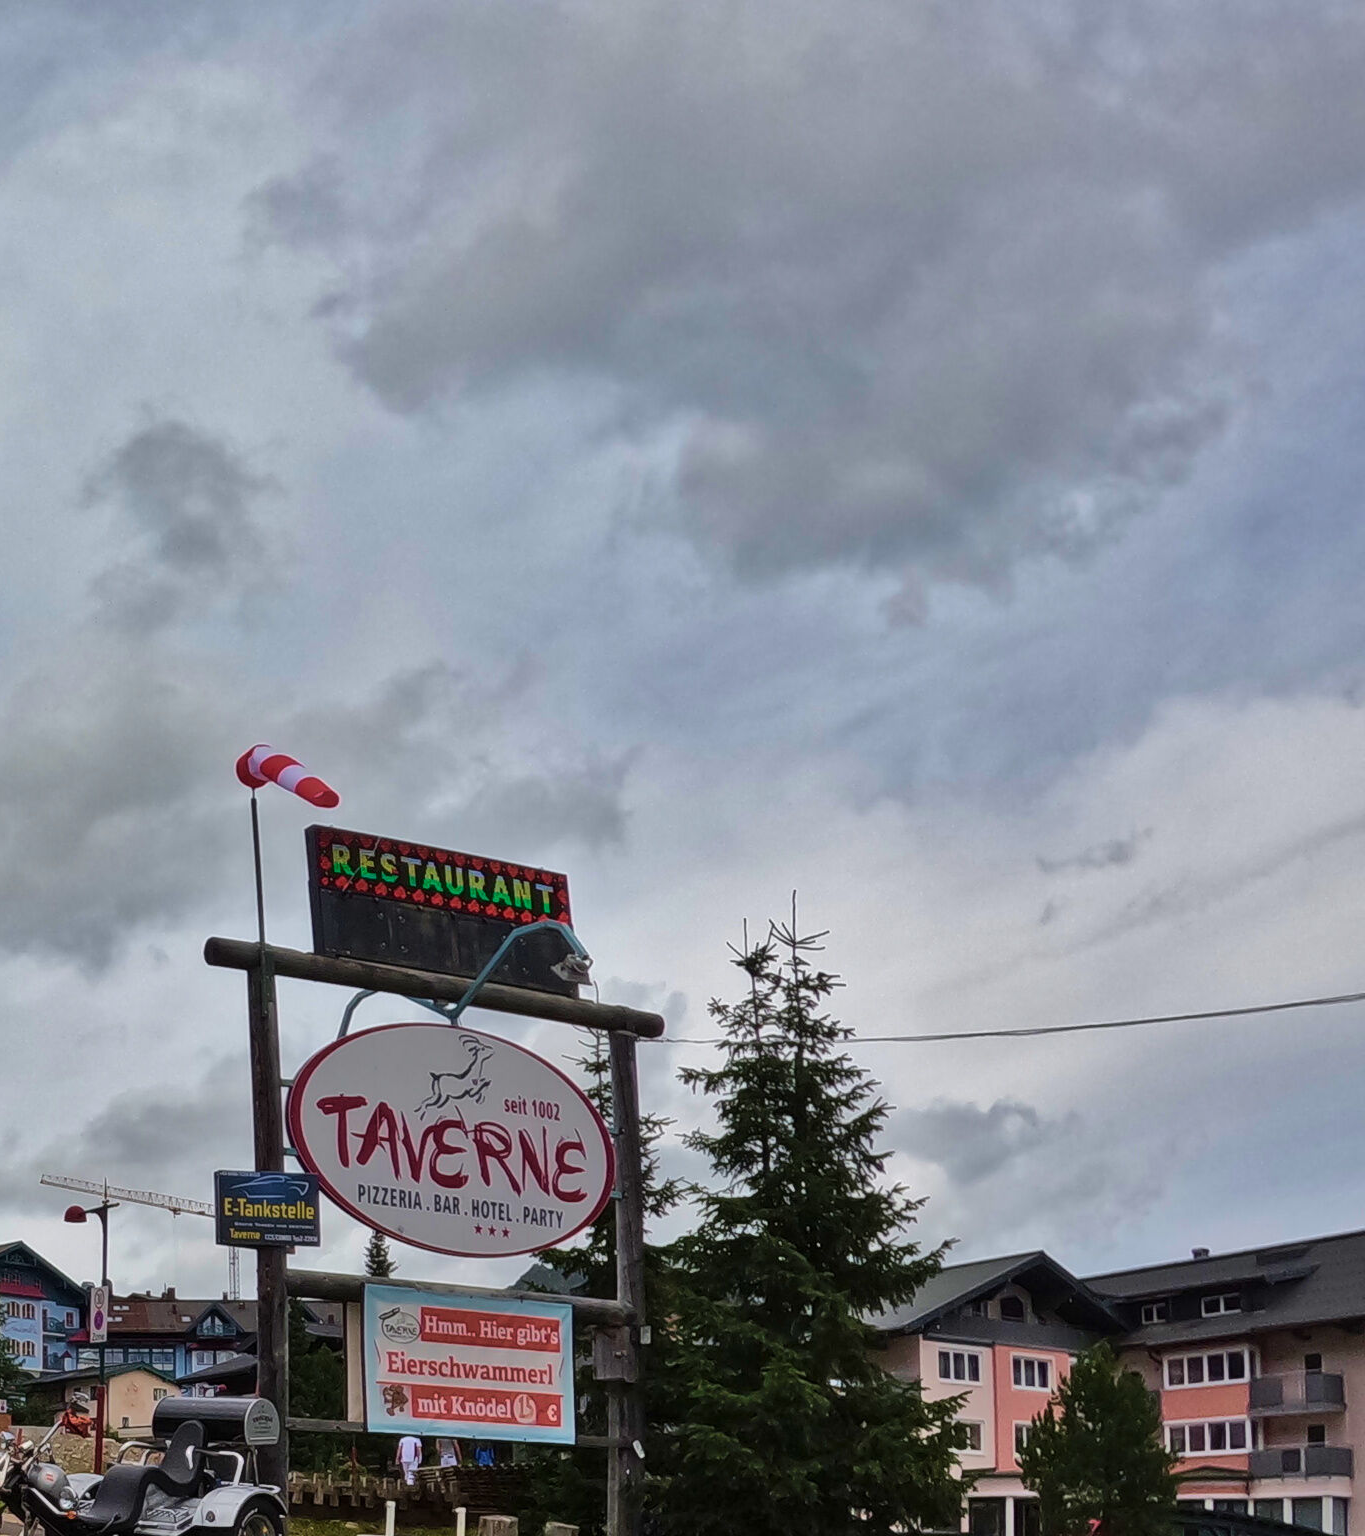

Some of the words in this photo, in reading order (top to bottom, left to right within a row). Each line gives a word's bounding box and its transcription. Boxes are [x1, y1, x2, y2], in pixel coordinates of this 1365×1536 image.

[332, 844, 554, 914] RESTAURANT
[504, 1095, 527, 1115] seit
[532, 1100, 560, 1121] 1002
[316, 1094, 587, 1203] TAVERNE
[224, 1197, 315, 1220] E-Tankstelle
[357, 1184, 422, 1211] PIZZERIA
[434, 1194, 460, 1215] BAR
[472, 1199, 512, 1222] HOTEL
[523, 1206, 563, 1228] PARTY
[229, 1228, 261, 1240] Taverne
[424, 1315, 476, 1337] Hmm..
[479, 1320, 513, 1340] Hier
[516, 1326, 559, 1345] gibt's
[386, 1351, 553, 1385] Eierschwammerl
[417, 1393, 447, 1414] mit
[451, 1395, 512, 1419] Knödel
[546, 1404, 558, 1422] €
